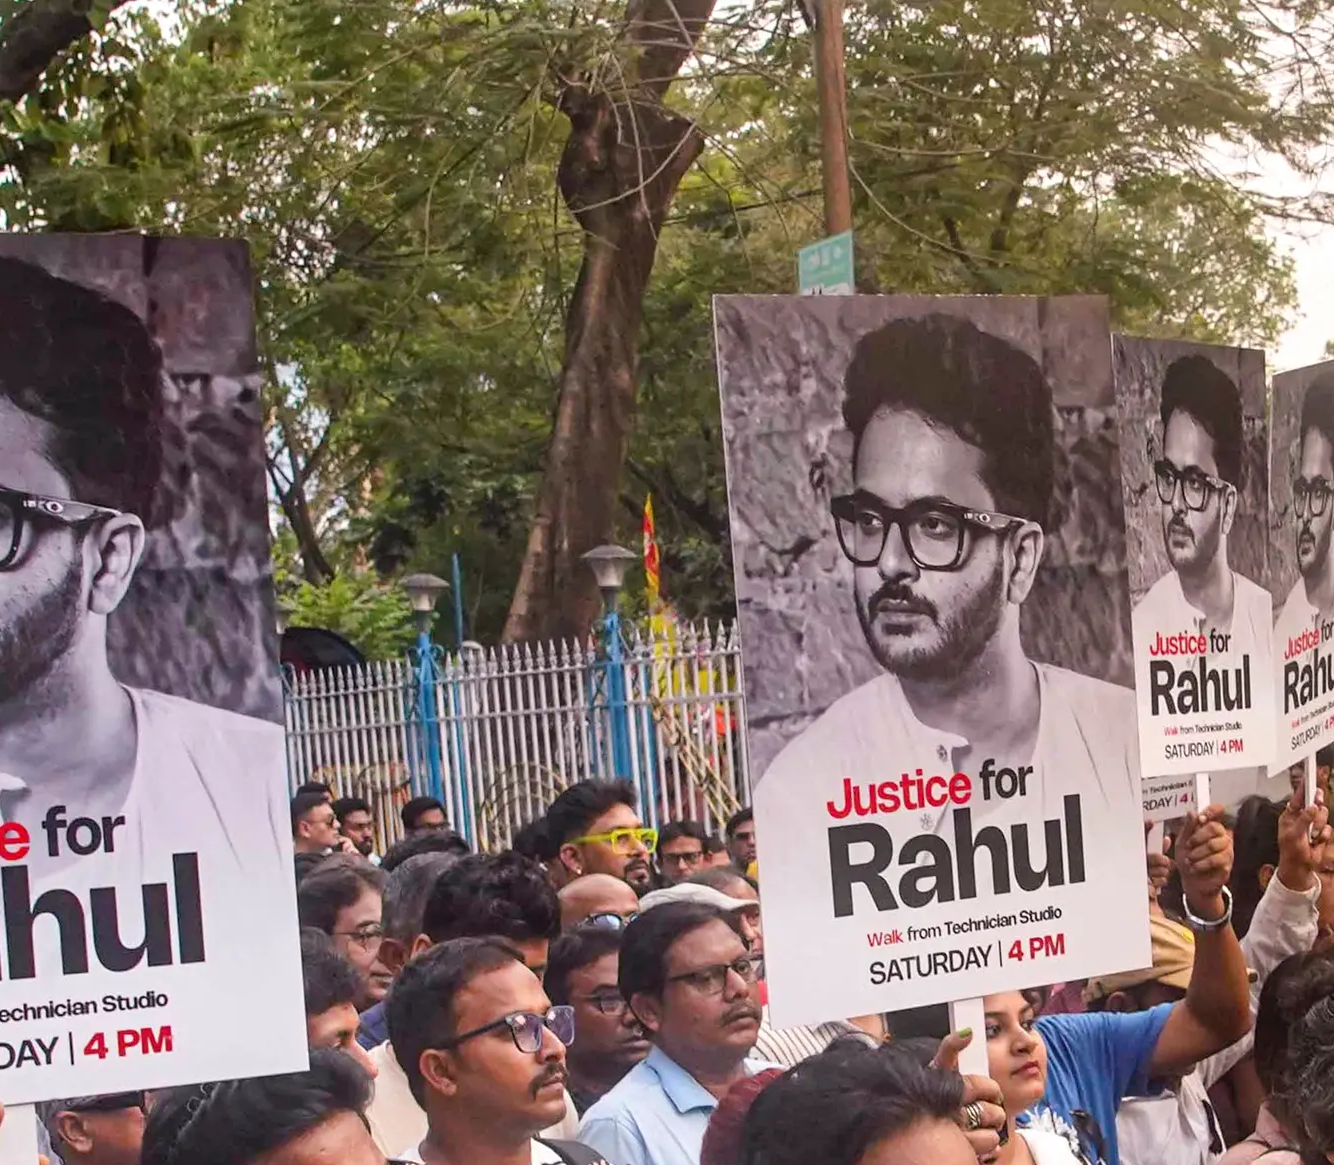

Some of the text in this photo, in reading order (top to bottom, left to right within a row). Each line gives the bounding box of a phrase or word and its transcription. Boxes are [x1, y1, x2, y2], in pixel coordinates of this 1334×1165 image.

[1149, 628, 1231, 656] Justice for
[1284, 618, 1334, 660] Justice for
[1149, 654, 1252, 716] Rahul
[1165, 739, 1214, 759] SATURDAY
[1220, 740, 1227, 753] 4
[1229, 738, 1244, 753] PM
[1179, 725, 1194, 734] from
[826, 758, 1033, 819] Justice for
[42, 804, 127, 857] for
[827, 793, 1086, 918] Rahul
[867, 905, 1062, 947] Walk from Technician Studio
[869, 945, 992, 985] SATURDAY
[1008, 938, 1024, 962] 4
[1029, 933, 1065, 960] PM
[101, 989, 168, 1014] Studio
[83, 1032, 108, 1061] 4
[118, 1025, 174, 1057] PM
